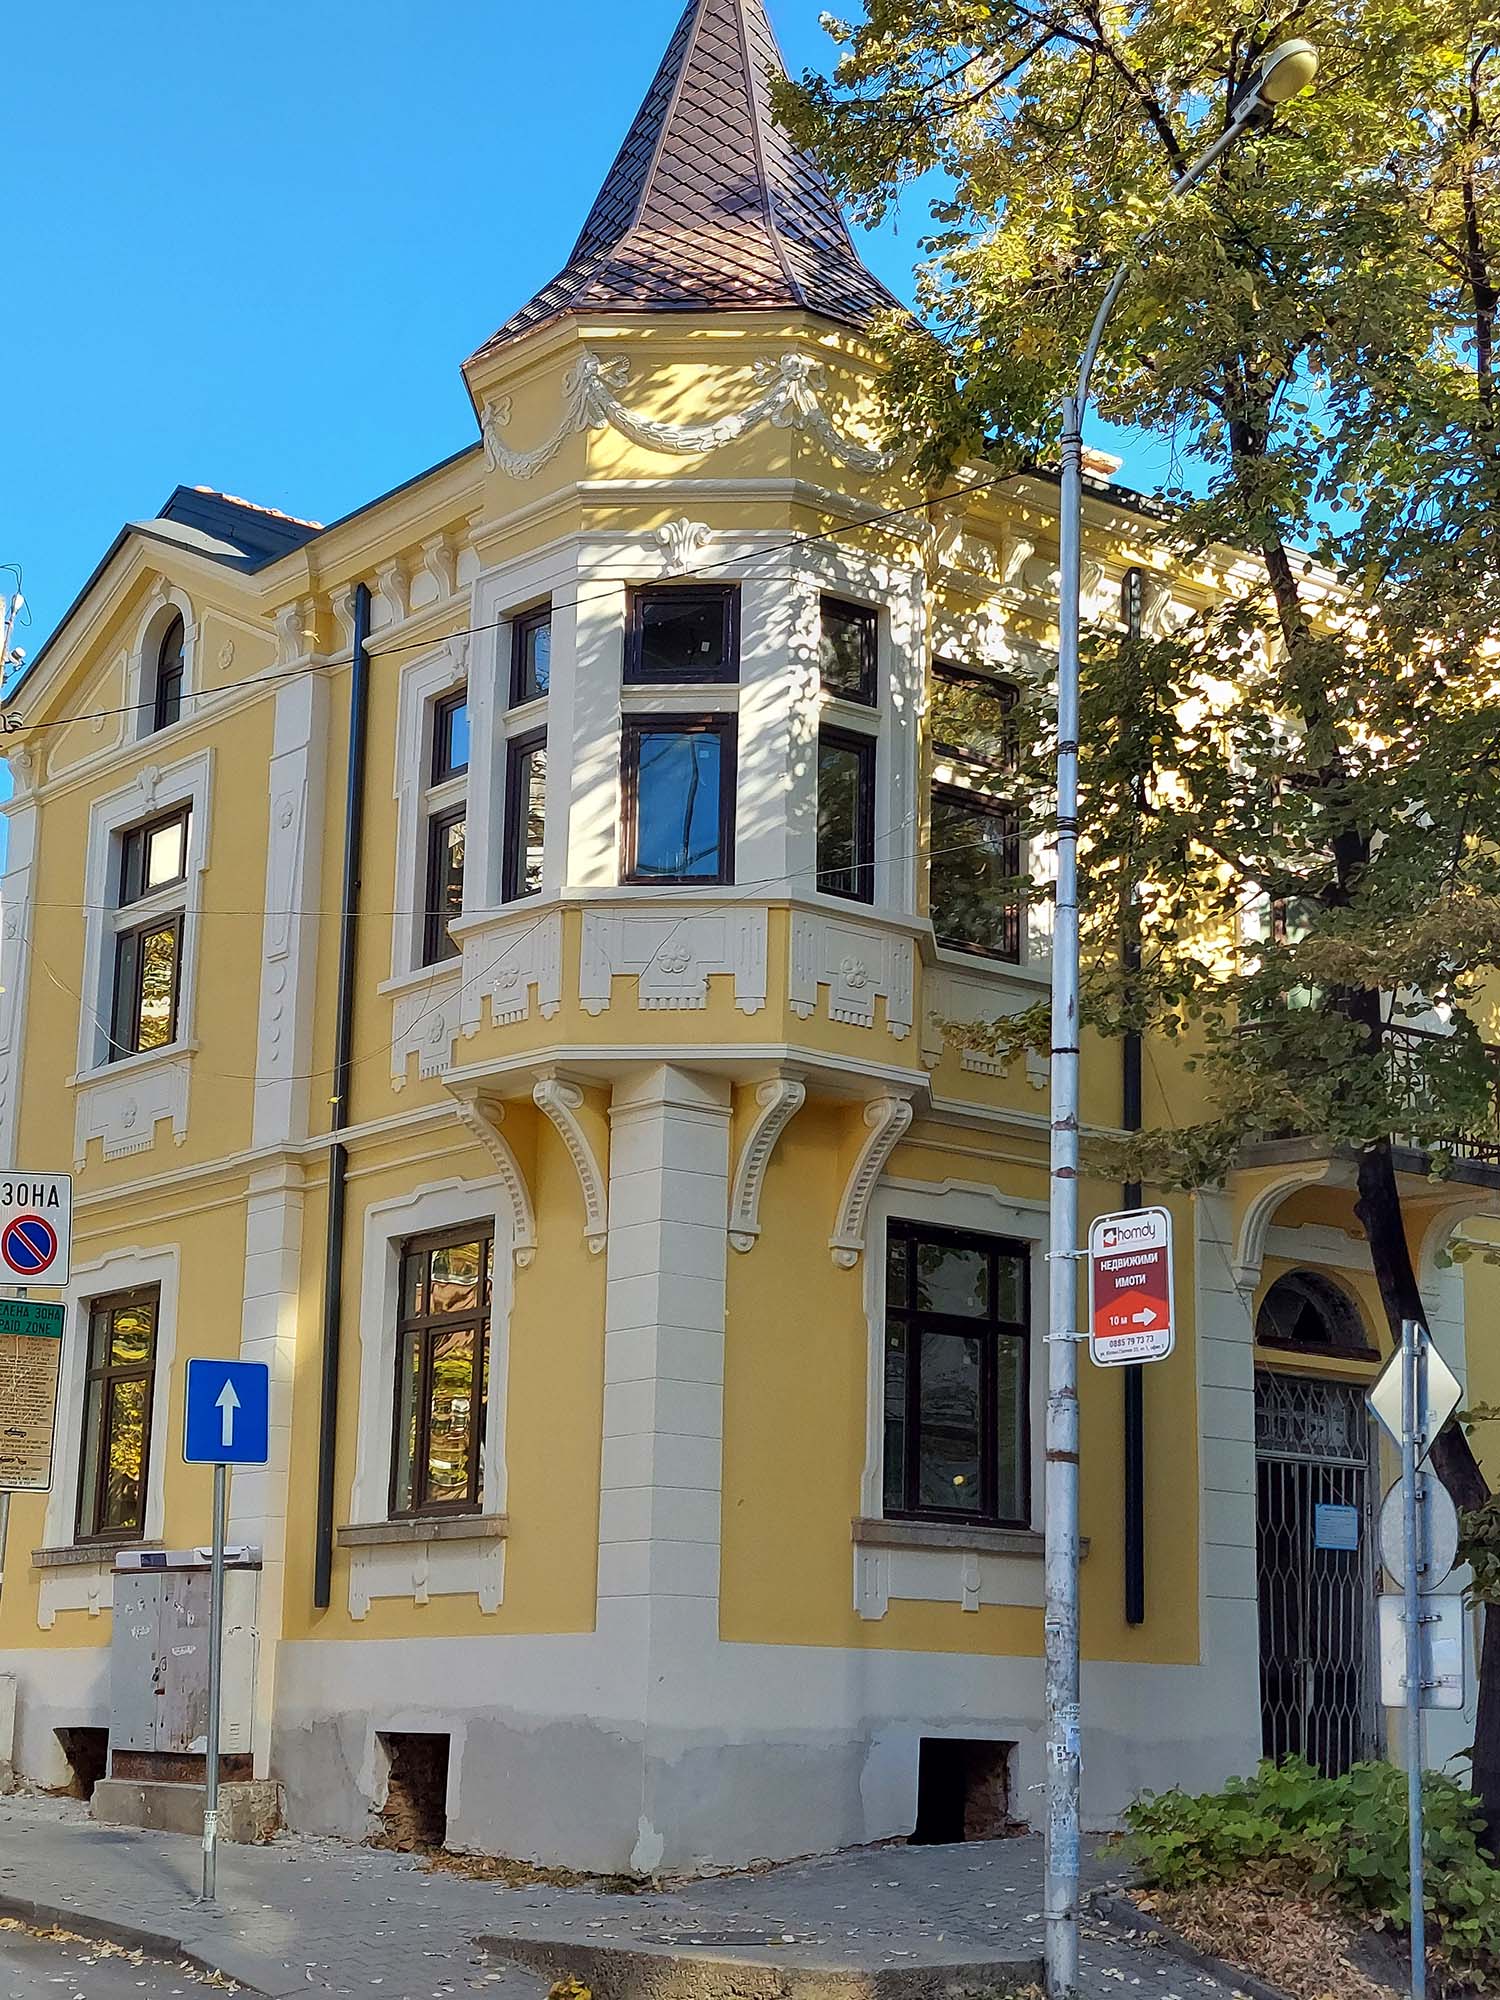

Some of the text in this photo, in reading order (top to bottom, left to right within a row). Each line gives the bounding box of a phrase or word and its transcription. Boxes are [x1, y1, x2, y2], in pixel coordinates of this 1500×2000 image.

[2, 1182, 60, 1208] ЗОНА
[1117, 1221, 1156, 1241] homdy
[1100, 1252, 1159, 1272] НЕДВИЖИМИ
[1115, 1273, 1146, 1288] ИМОТИ
[35, 1307, 60, 1321] ЗОНА
[1109, 1316, 1120, 1326] 10
[0, 1319, 52, 1335] PAID ZONE
[1136, 1335, 1145, 1344] 73
[1145, 1334, 1154, 1343] 73
